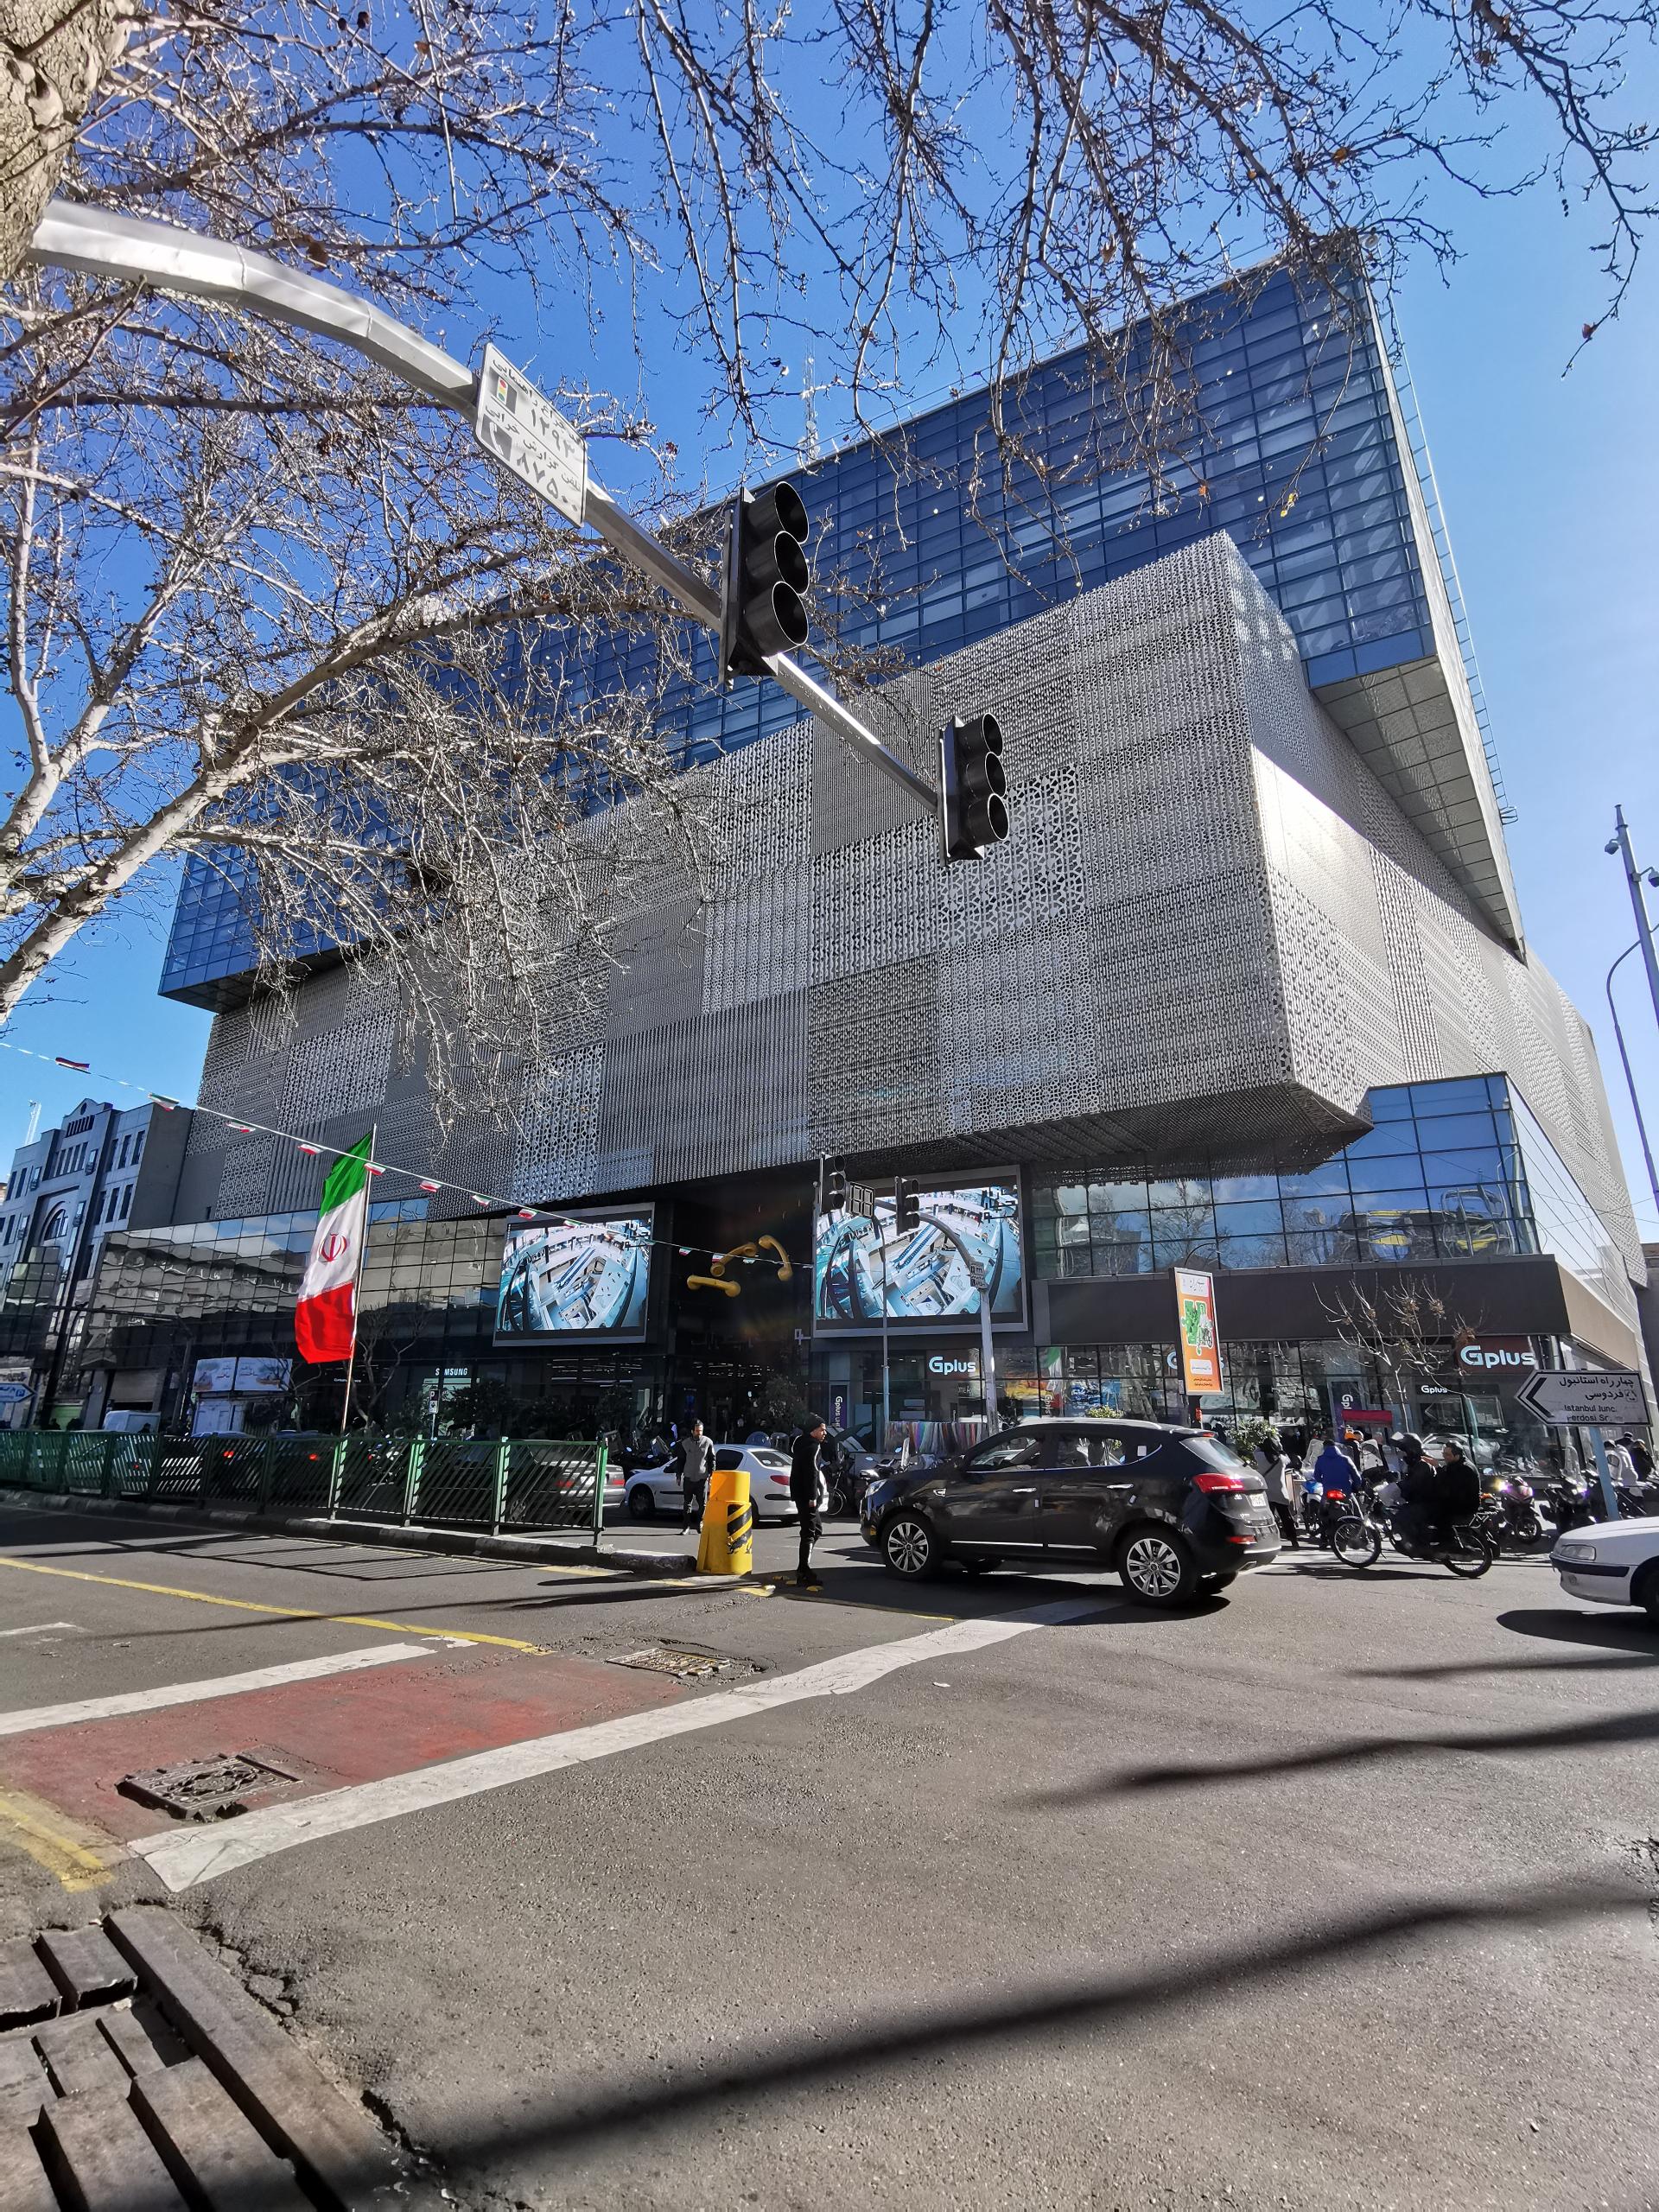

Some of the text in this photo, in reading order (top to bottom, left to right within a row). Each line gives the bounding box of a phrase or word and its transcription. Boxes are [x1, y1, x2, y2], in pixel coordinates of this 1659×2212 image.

[493, 359, 538, 407] راهنمایی
[541, 405, 566, 434] چراغ
[485, 405, 581, 493] تلفن گزارش خرابی
[516, 451, 578, 512] ۸۷۵۰۰
[928, 1356, 976, 1375] Gplus
[1460, 1344, 1536, 1369] Gplus
[1421, 1384, 1448, 1395] Gplus
[1559, 1376, 1634, 1389] چهار راه استانبول
[1585, 1389, 1624, 1401] فردوسی
